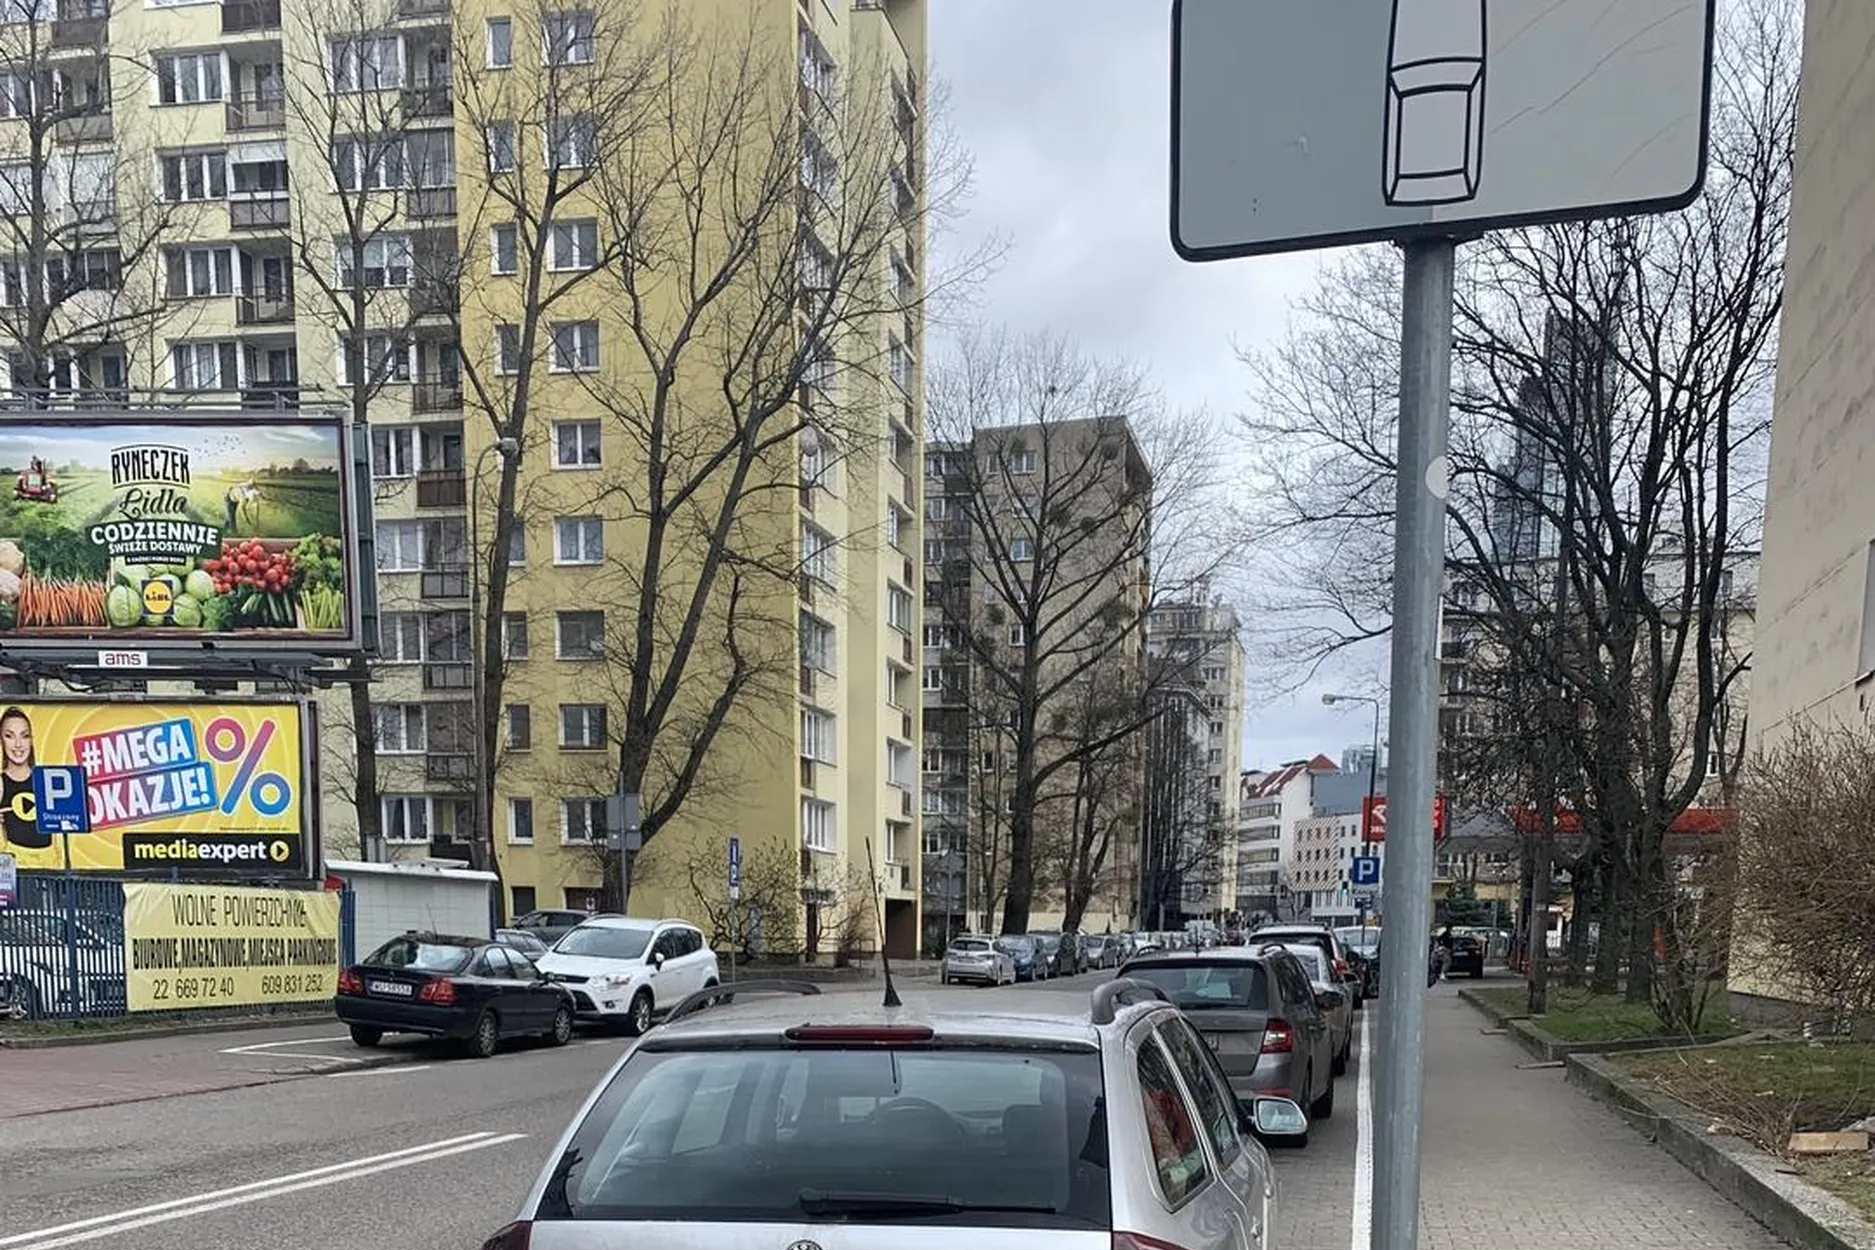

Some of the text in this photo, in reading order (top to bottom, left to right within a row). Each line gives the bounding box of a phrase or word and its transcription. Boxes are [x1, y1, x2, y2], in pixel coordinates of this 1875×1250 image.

[111, 449, 190, 484] RYNECZEK
[119, 488, 188, 520] Lidla
[91, 522, 218, 545] CODZIENNIE
[108, 541, 202, 554] ŚWIEŻE DOSTAWY
[105, 653, 141, 665] ams
[82, 724, 192, 777] #MEGA
[204, 717, 291, 816] %
[43, 769, 73, 810] P
[134, 838, 267, 863] mediaexpert
[1359, 860, 1375, 880] P
[172, 894, 307, 928] WOLNE POWIERZCHNIE
[153, 979, 169, 1000] 22
[176, 978, 198, 998] 669
[202, 977, 217, 997] 72
[220, 976, 234, 996] 40
[261, 975, 282, 995] 609
[284, 974, 303, 994] 831
